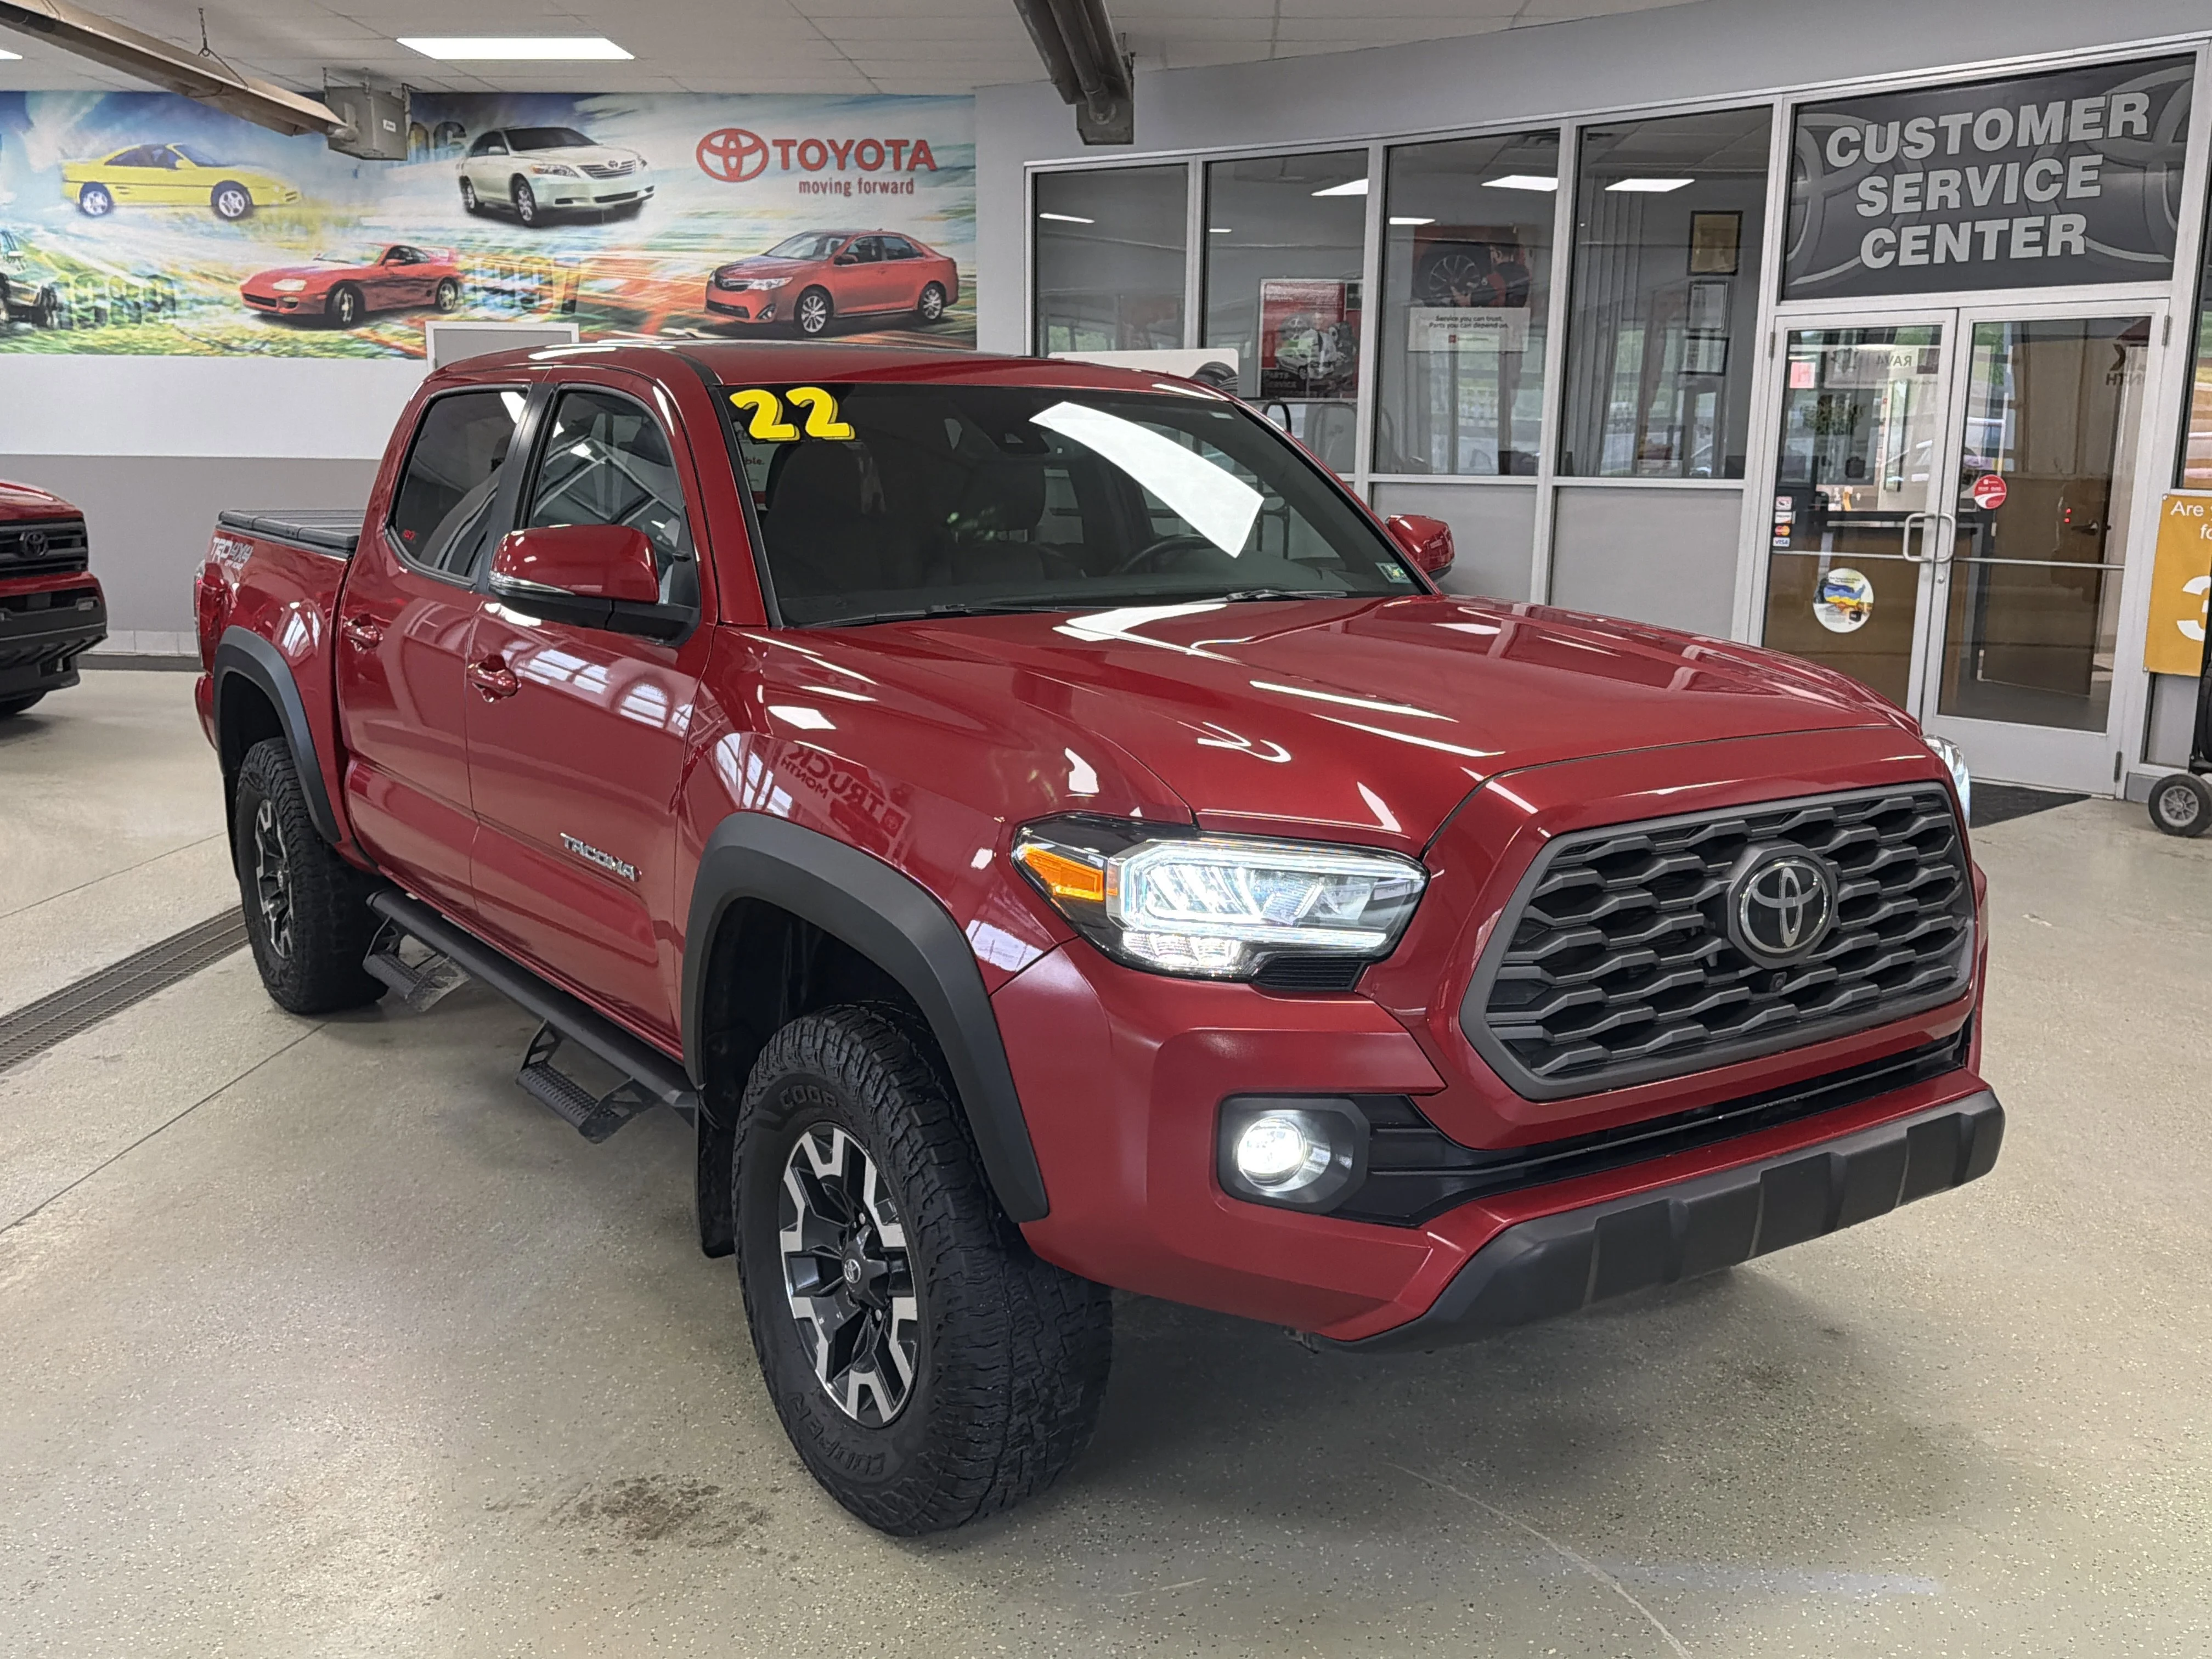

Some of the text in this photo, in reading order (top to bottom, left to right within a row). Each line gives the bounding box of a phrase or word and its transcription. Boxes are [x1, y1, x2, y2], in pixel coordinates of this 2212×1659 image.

[1826, 91, 2149, 168] CUSTOMER
[772, 138, 937, 172] TOYOTA
[799, 177, 914, 197] moving forward
[1856, 154, 2103, 218] SERVICE
[1860, 213, 2087, 269] CENTER
[729, 387, 855, 442] 22
[744, 456, 765, 465] ble.
[2170, 500, 2204, 517] Are
[211, 537, 233, 565] TRD
[560, 832, 635, 882] TACOMA
